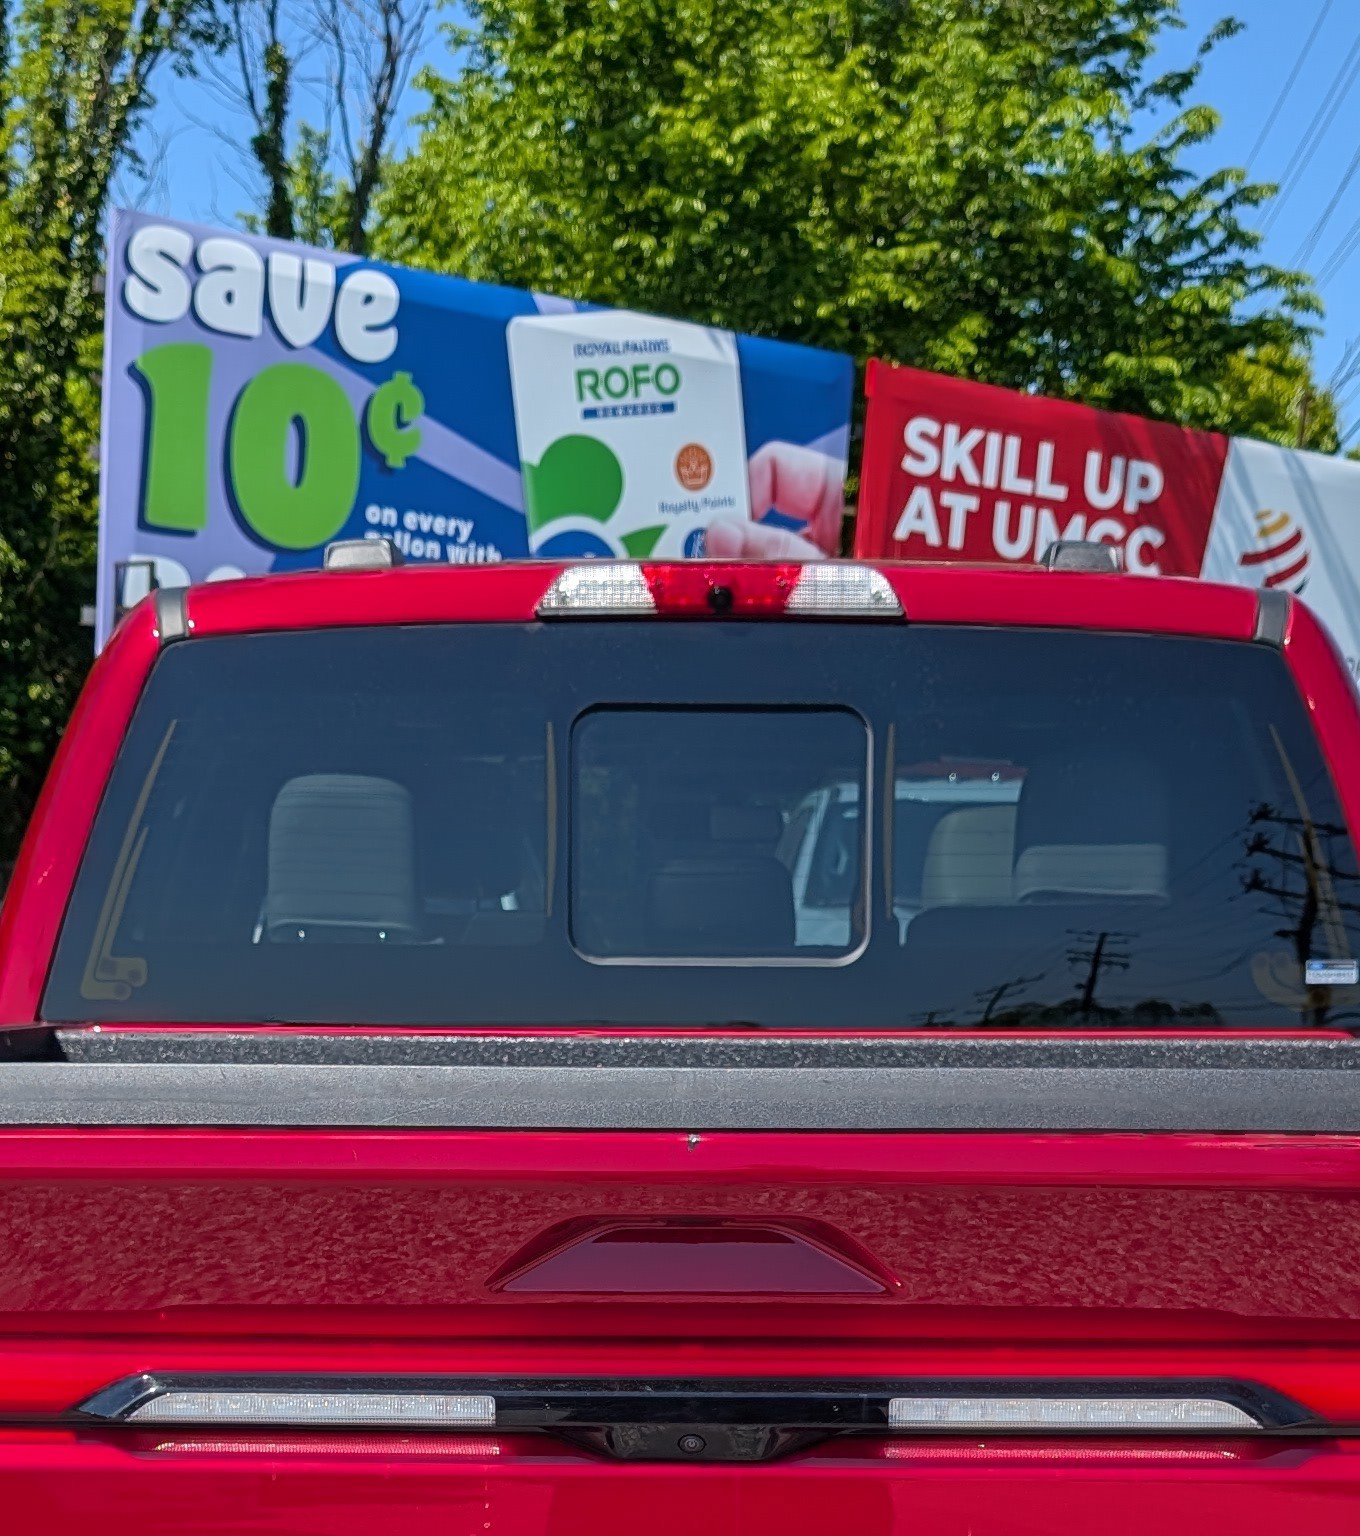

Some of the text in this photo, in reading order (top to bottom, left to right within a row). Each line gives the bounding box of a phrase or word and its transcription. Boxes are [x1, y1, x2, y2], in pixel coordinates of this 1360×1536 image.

[124, 224, 401, 363] save
[575, 362, 681, 402] ROFO
[900, 416, 1165, 515] SKILL UP
[365, 504, 474, 544] on every
[893, 485, 981, 551] AT
[364, 530, 502, 564] llon with
